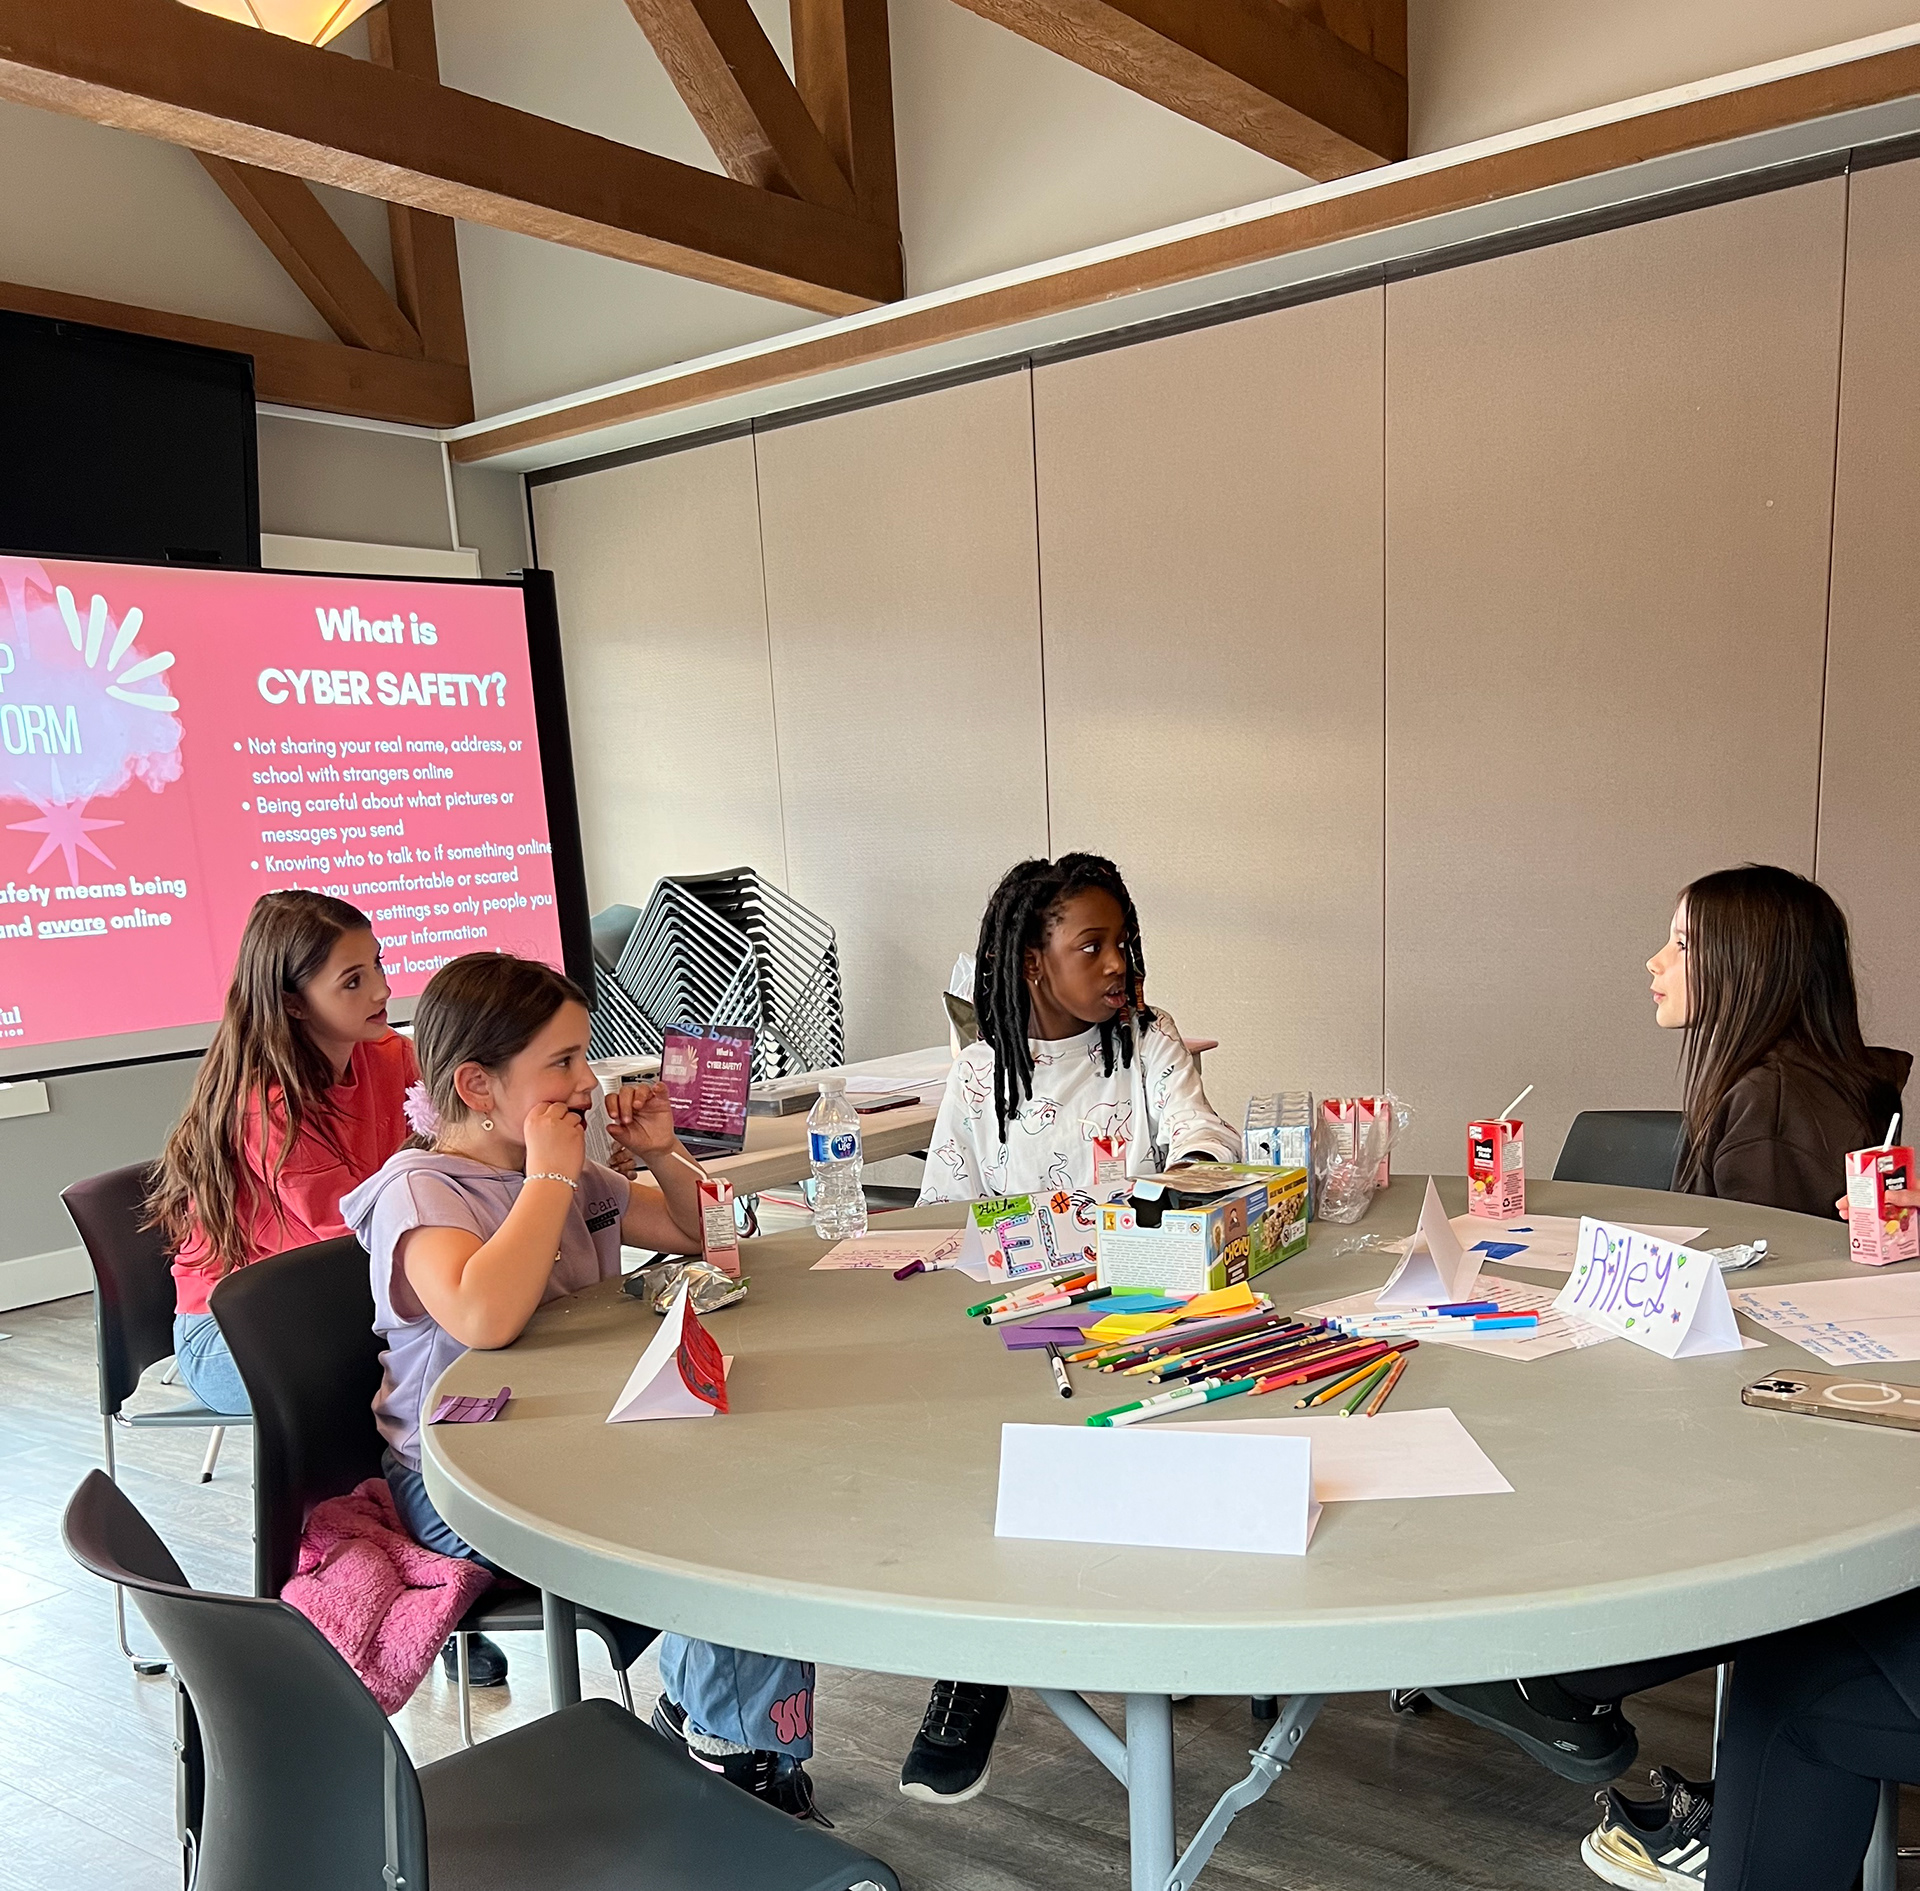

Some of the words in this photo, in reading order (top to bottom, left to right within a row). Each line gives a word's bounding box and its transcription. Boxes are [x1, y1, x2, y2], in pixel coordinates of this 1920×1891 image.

[315, 606, 404, 643] What
[409, 612, 438, 645] is
[257, 668, 373, 705] CYBER
[376, 671, 506, 707] SAFETY?
[0, 704, 82, 755] ORM
[248, 737, 276, 755] Not
[281, 736, 336, 758] sharing
[340, 739, 371, 758] your
[374, 735, 402, 753] real
[406, 738, 448, 754] name,
[451, 735, 506, 753] address,
[509, 739, 522, 752] or
[252, 764, 303, 784] school
[307, 764, 339, 782] with
[343, 766, 409, 785] strangers
[413, 763, 453, 780] online
[256, 796, 302, 817] Being
[305, 792, 358, 811] careful
[361, 791, 404, 809] about
[407, 790, 441, 807] what
[445, 791, 498, 810] pictures
[500, 792, 514, 804] or
[261, 827, 337, 845] messages
[340, 827, 366, 843] you
[370, 818, 404, 837] send
[265, 855, 330, 873] Knowing
[333, 850, 365, 868] who
[368, 851, 383, 865] to
[387, 846, 413, 864] talk
[416, 848, 431, 862] to
[434, 844, 443, 861] if
[447, 840, 514, 860] something
[517, 838, 552, 855] online
[55, 884, 127, 900] means
[129, 875, 187, 898] being
[322, 884, 349, 898] you
[352, 870, 454, 894] uncomfortable
[457, 874, 471, 887] or
[475, 865, 519, 885] scared
[376, 904, 431, 922] settings
[433, 903, 449, 915] so
[453, 895, 480, 916] only
[482, 892, 527, 914] people
[530, 894, 553, 911] you
[38, 917, 108, 937] aware
[110, 907, 172, 929] online
[377, 934, 407, 957] your
[411, 925, 488, 944] information
[382, 962, 401, 975] ur
[0, 1006, 22, 1025] ul
[588, 1197, 617, 1216] Can
[978, 1201, 999, 1216] Hi!
[1574, 1227, 1673, 1317] Riley
